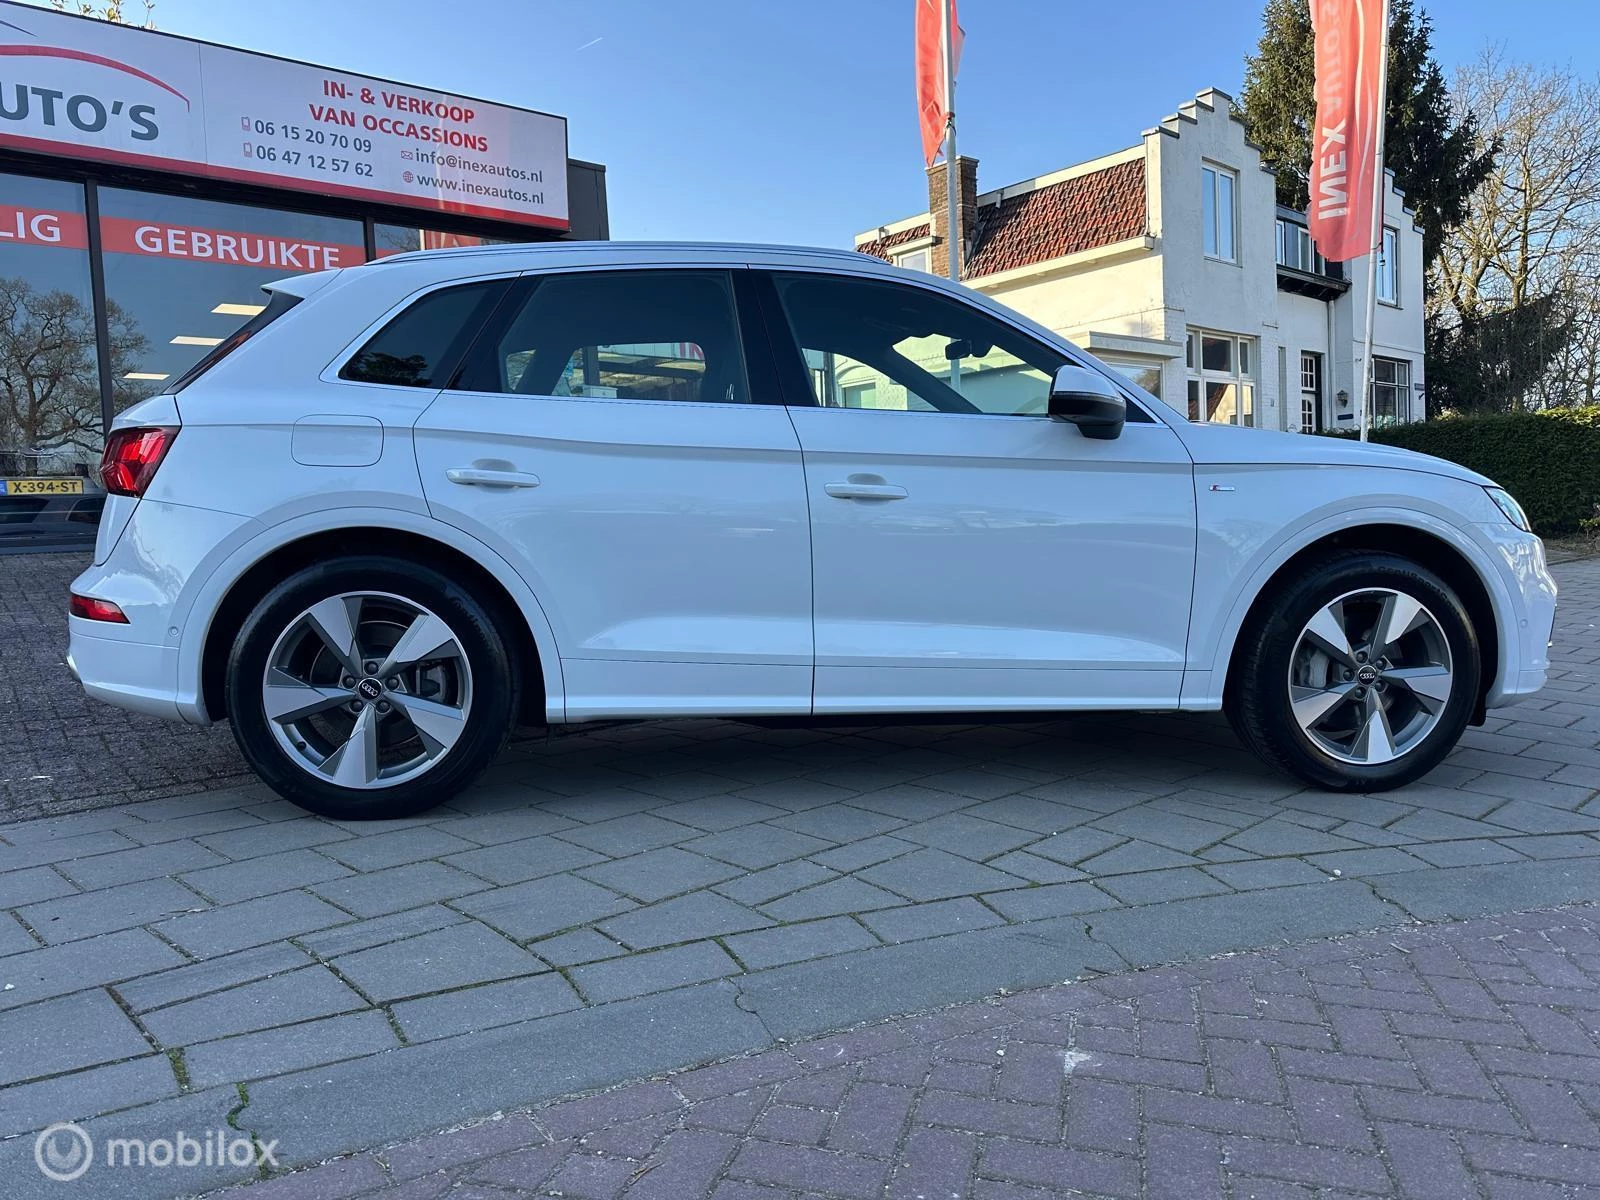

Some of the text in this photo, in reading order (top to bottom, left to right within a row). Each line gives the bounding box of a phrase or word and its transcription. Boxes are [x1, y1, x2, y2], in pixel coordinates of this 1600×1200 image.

[323, 79, 475, 124] IN- & VERKOOP
[254, 119, 372, 153] 06 15 20 70 09
[308, 103, 488, 152] VAN OCCASSIONS
[256, 145, 373, 177] 06 47 12 57 62
[415, 148, 543, 183] info@inexautos.nl
[416, 175, 544, 204] www.inexautos.nl
[134, 225, 340, 270] GEBRUIKTE
[13, 481, 78, 493] X-394-ST
